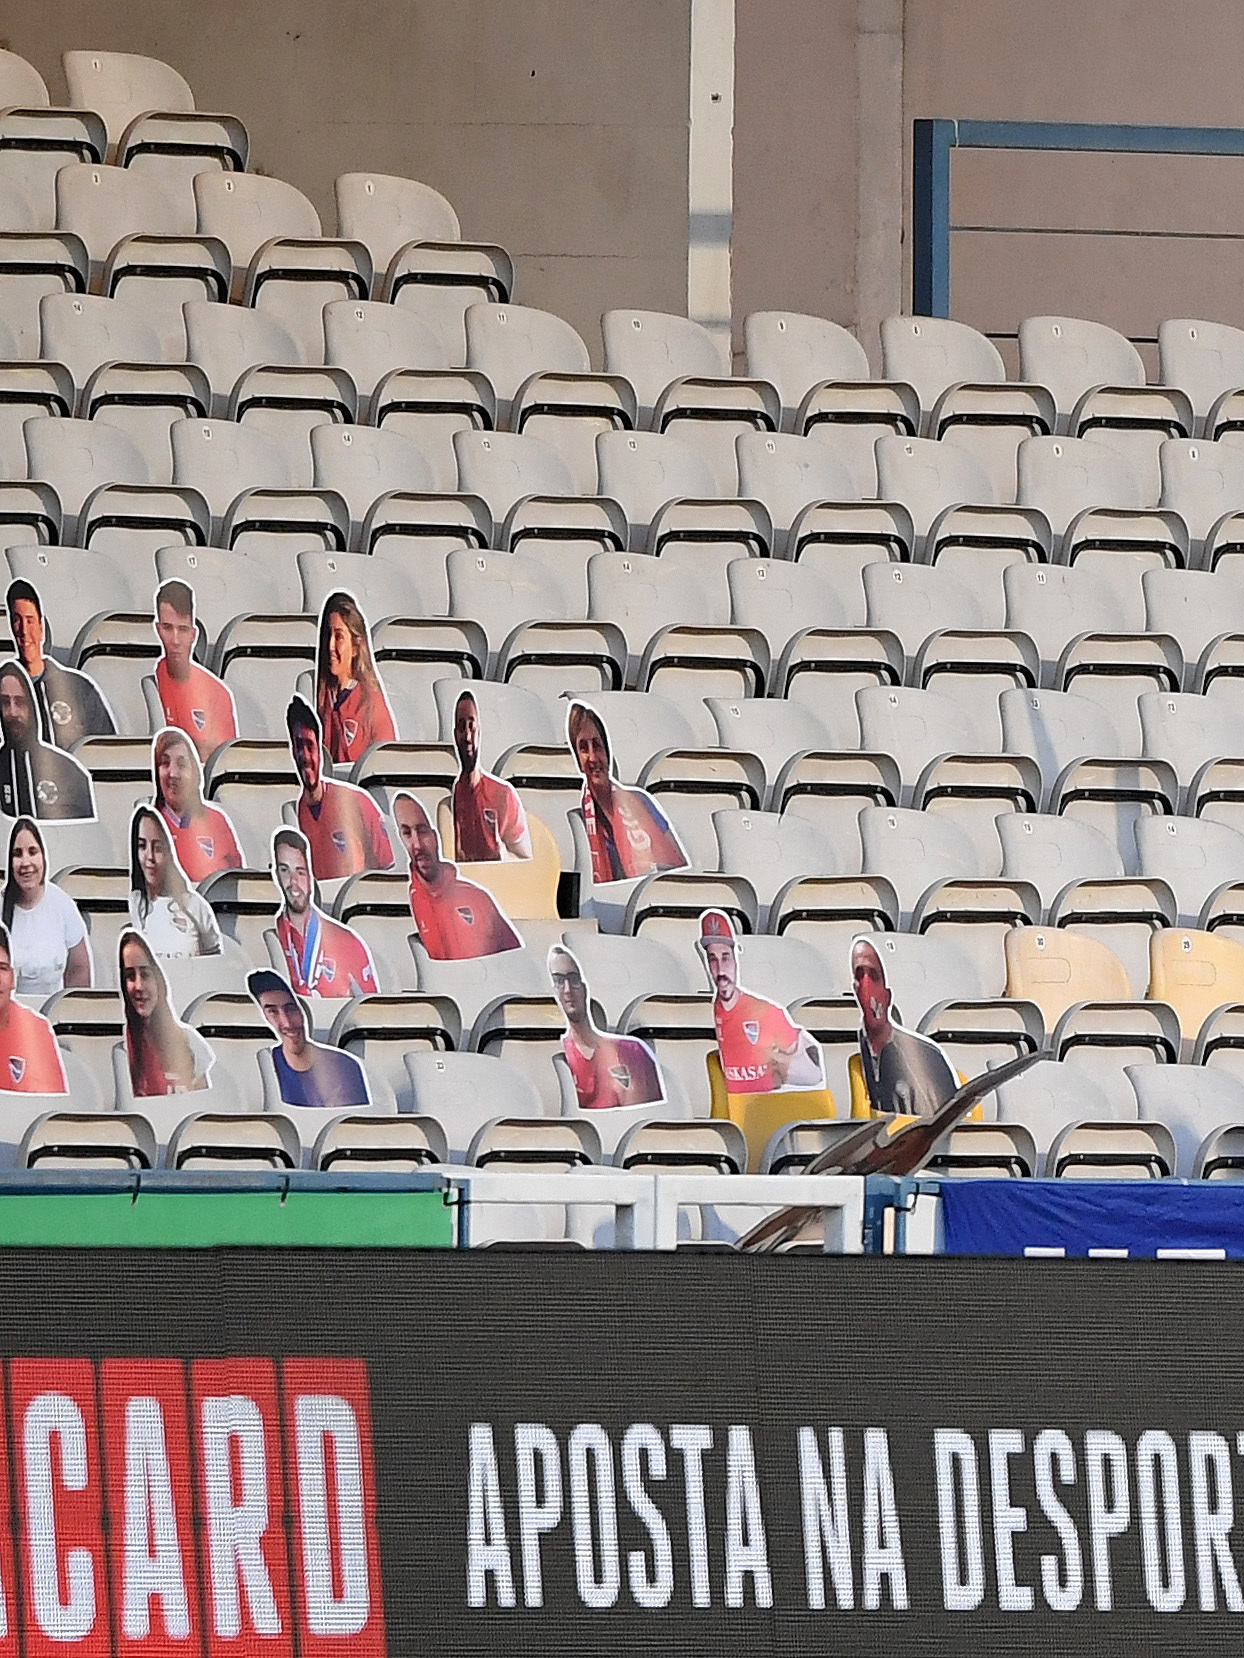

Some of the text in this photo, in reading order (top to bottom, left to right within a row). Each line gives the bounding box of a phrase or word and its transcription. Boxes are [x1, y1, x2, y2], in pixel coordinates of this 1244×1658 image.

[0, 1391, 370, 1643] CARD
[467, 1423, 773, 1608] APOSTA
[798, 1426, 910, 1610] NA
